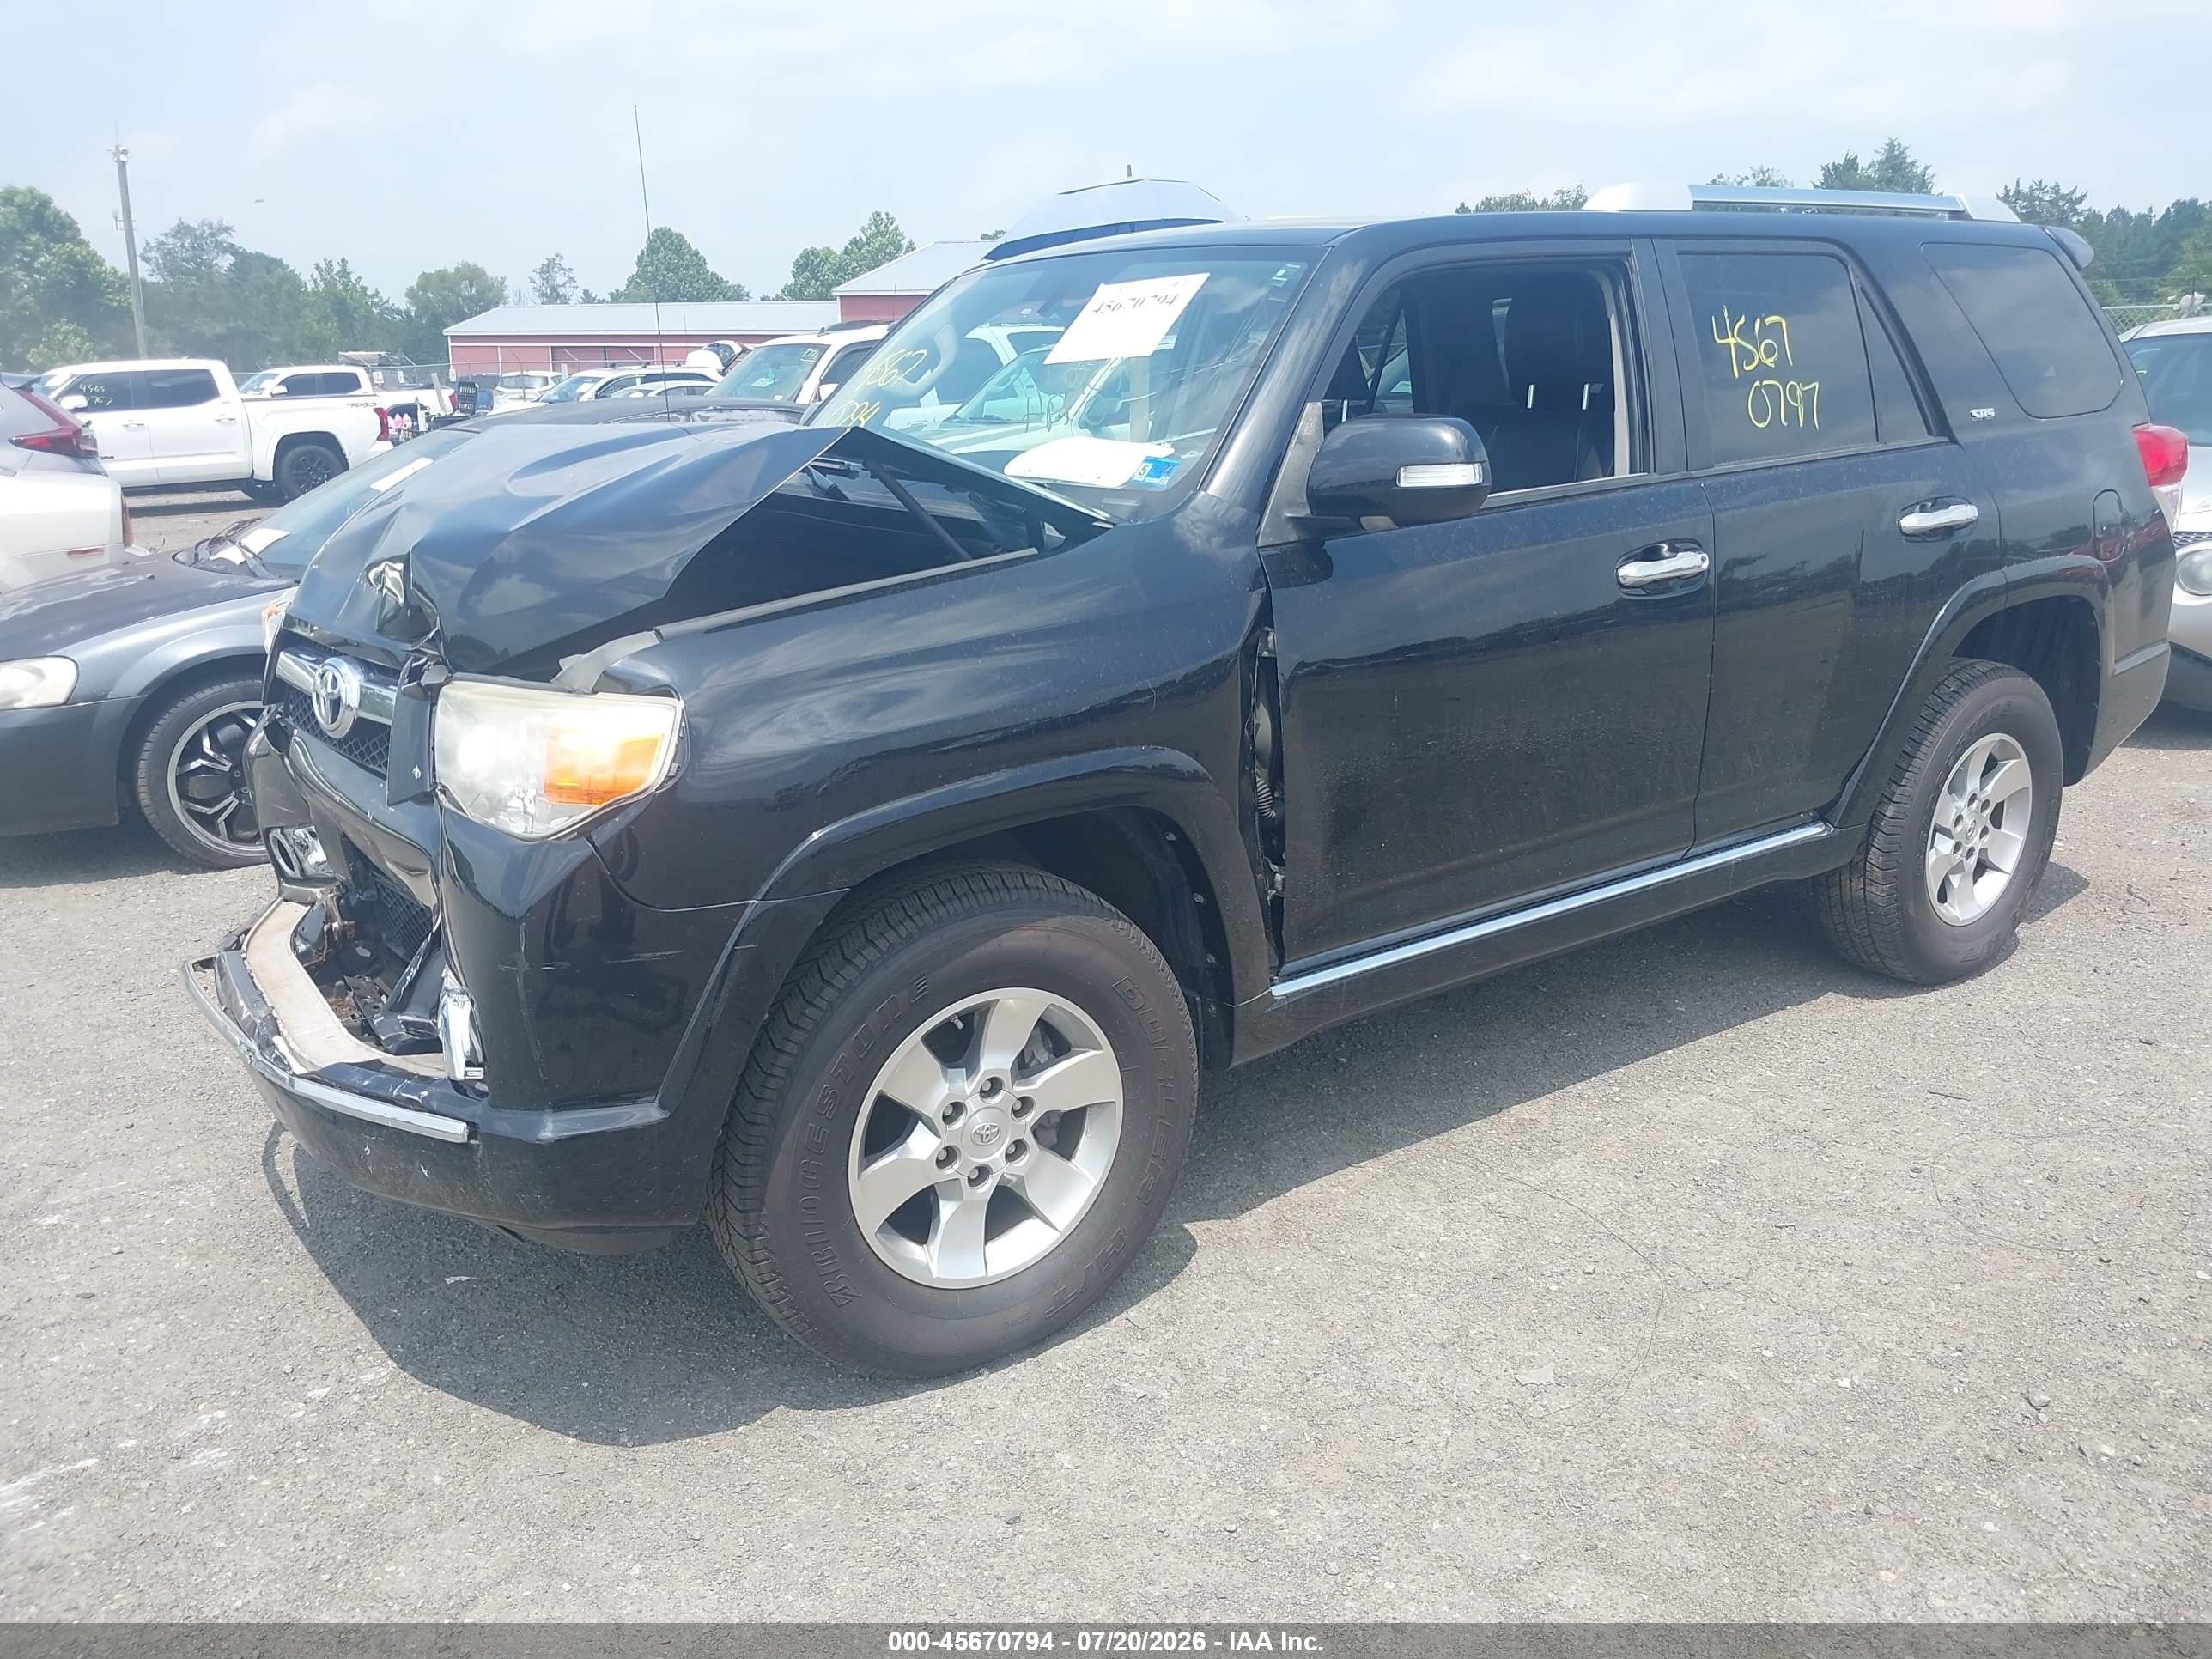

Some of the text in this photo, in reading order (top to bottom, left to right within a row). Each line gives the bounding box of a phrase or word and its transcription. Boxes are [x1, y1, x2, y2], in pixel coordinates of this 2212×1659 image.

[1711, 304, 1793, 379] 4567
[1139, 464, 1150, 477] 5
[798, 972, 930, 1309] BRIDGESTONE
